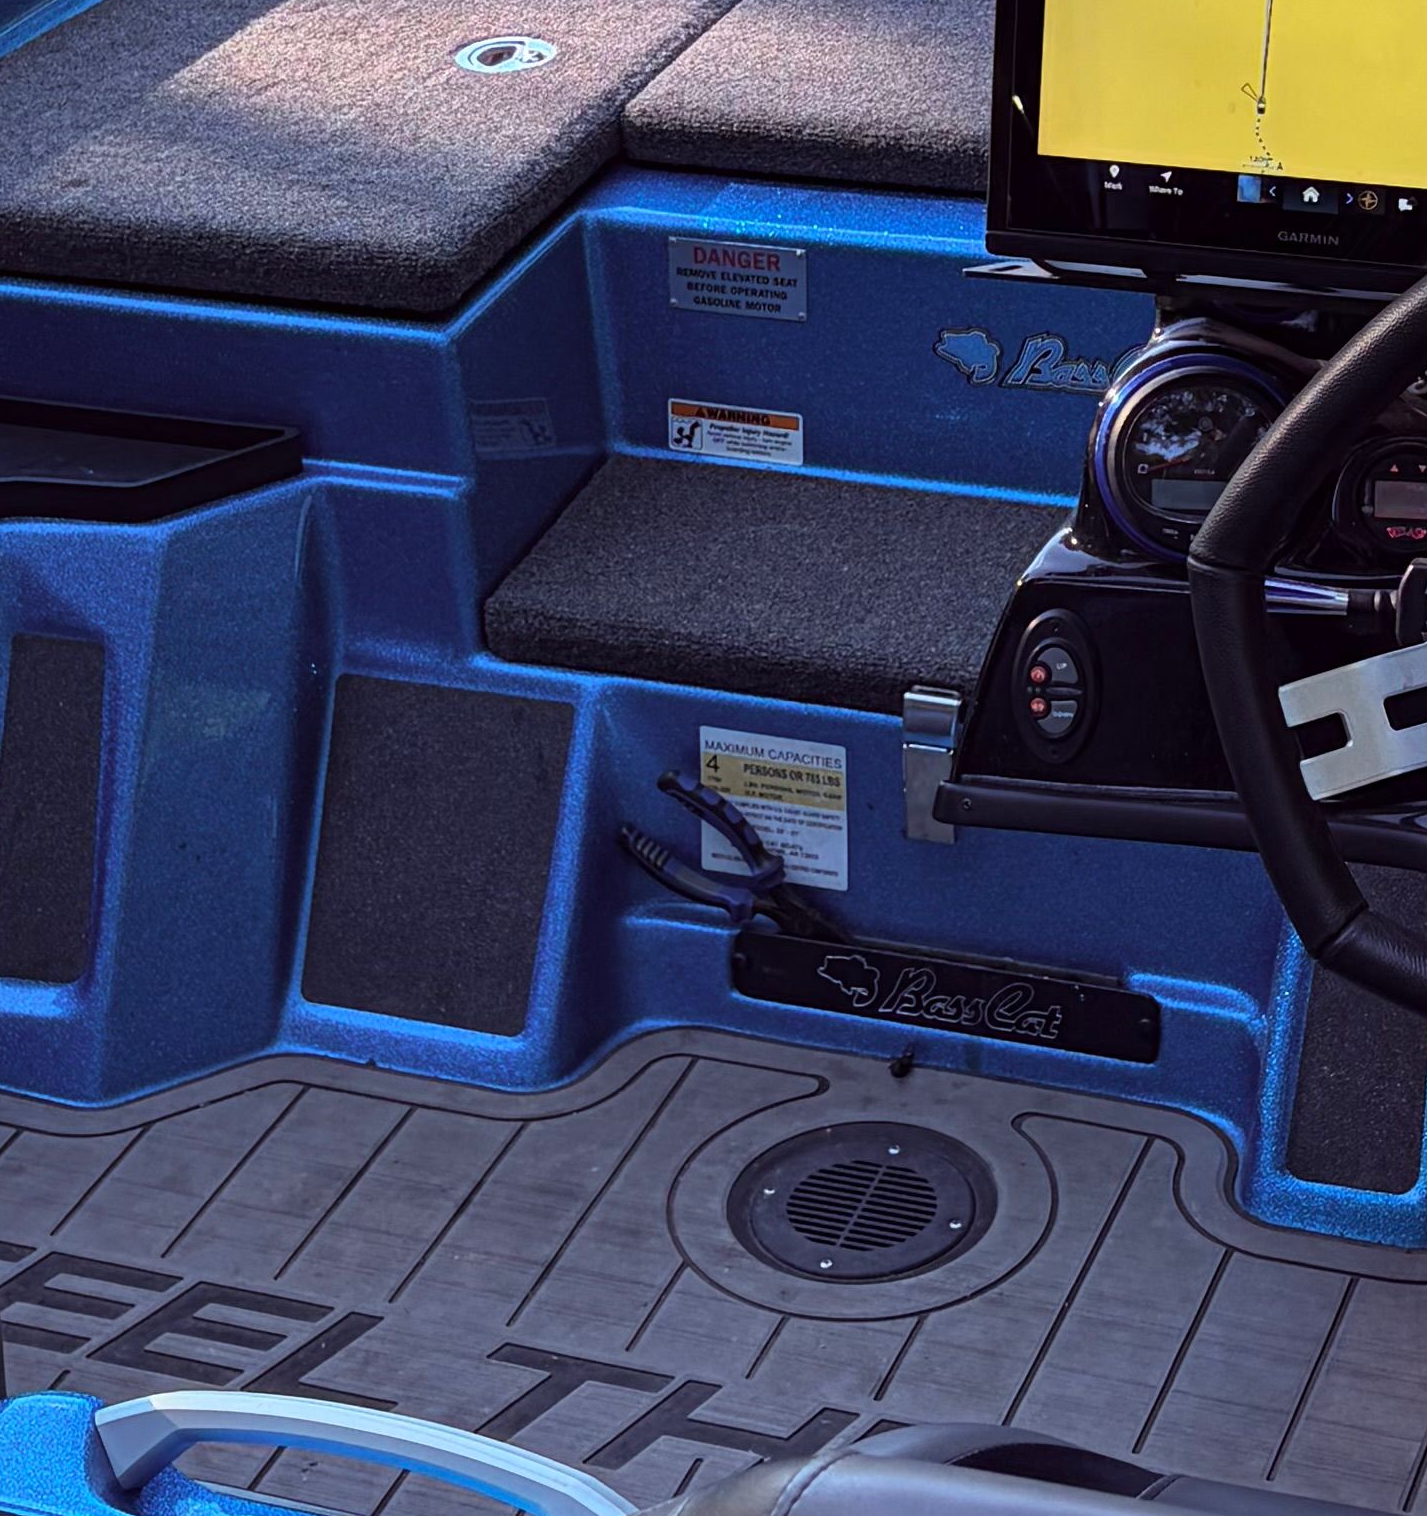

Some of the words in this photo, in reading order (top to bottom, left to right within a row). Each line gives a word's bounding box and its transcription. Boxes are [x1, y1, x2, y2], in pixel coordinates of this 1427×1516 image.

[1277, 230, 1340, 246] GARMIN
[693, 246, 781, 272] DANGER
[676, 267, 717, 280] REMOVE
[720, 271, 770, 285] ELEVATED
[773, 277, 798, 288] SEAT
[687, 282, 727, 294] BEFORE
[730, 286, 788, 301] OPERATING
[693, 296, 743, 310] GASOLINE
[746, 301, 781, 313] MOTOR
[706, 407, 771, 425] WARNING
[704, 740, 765, 758] MAXIMUM
[767, 748, 843, 770] CAPACITIES
[706, 754, 720, 773] 4
[743, 763, 788, 780] PERSONS
